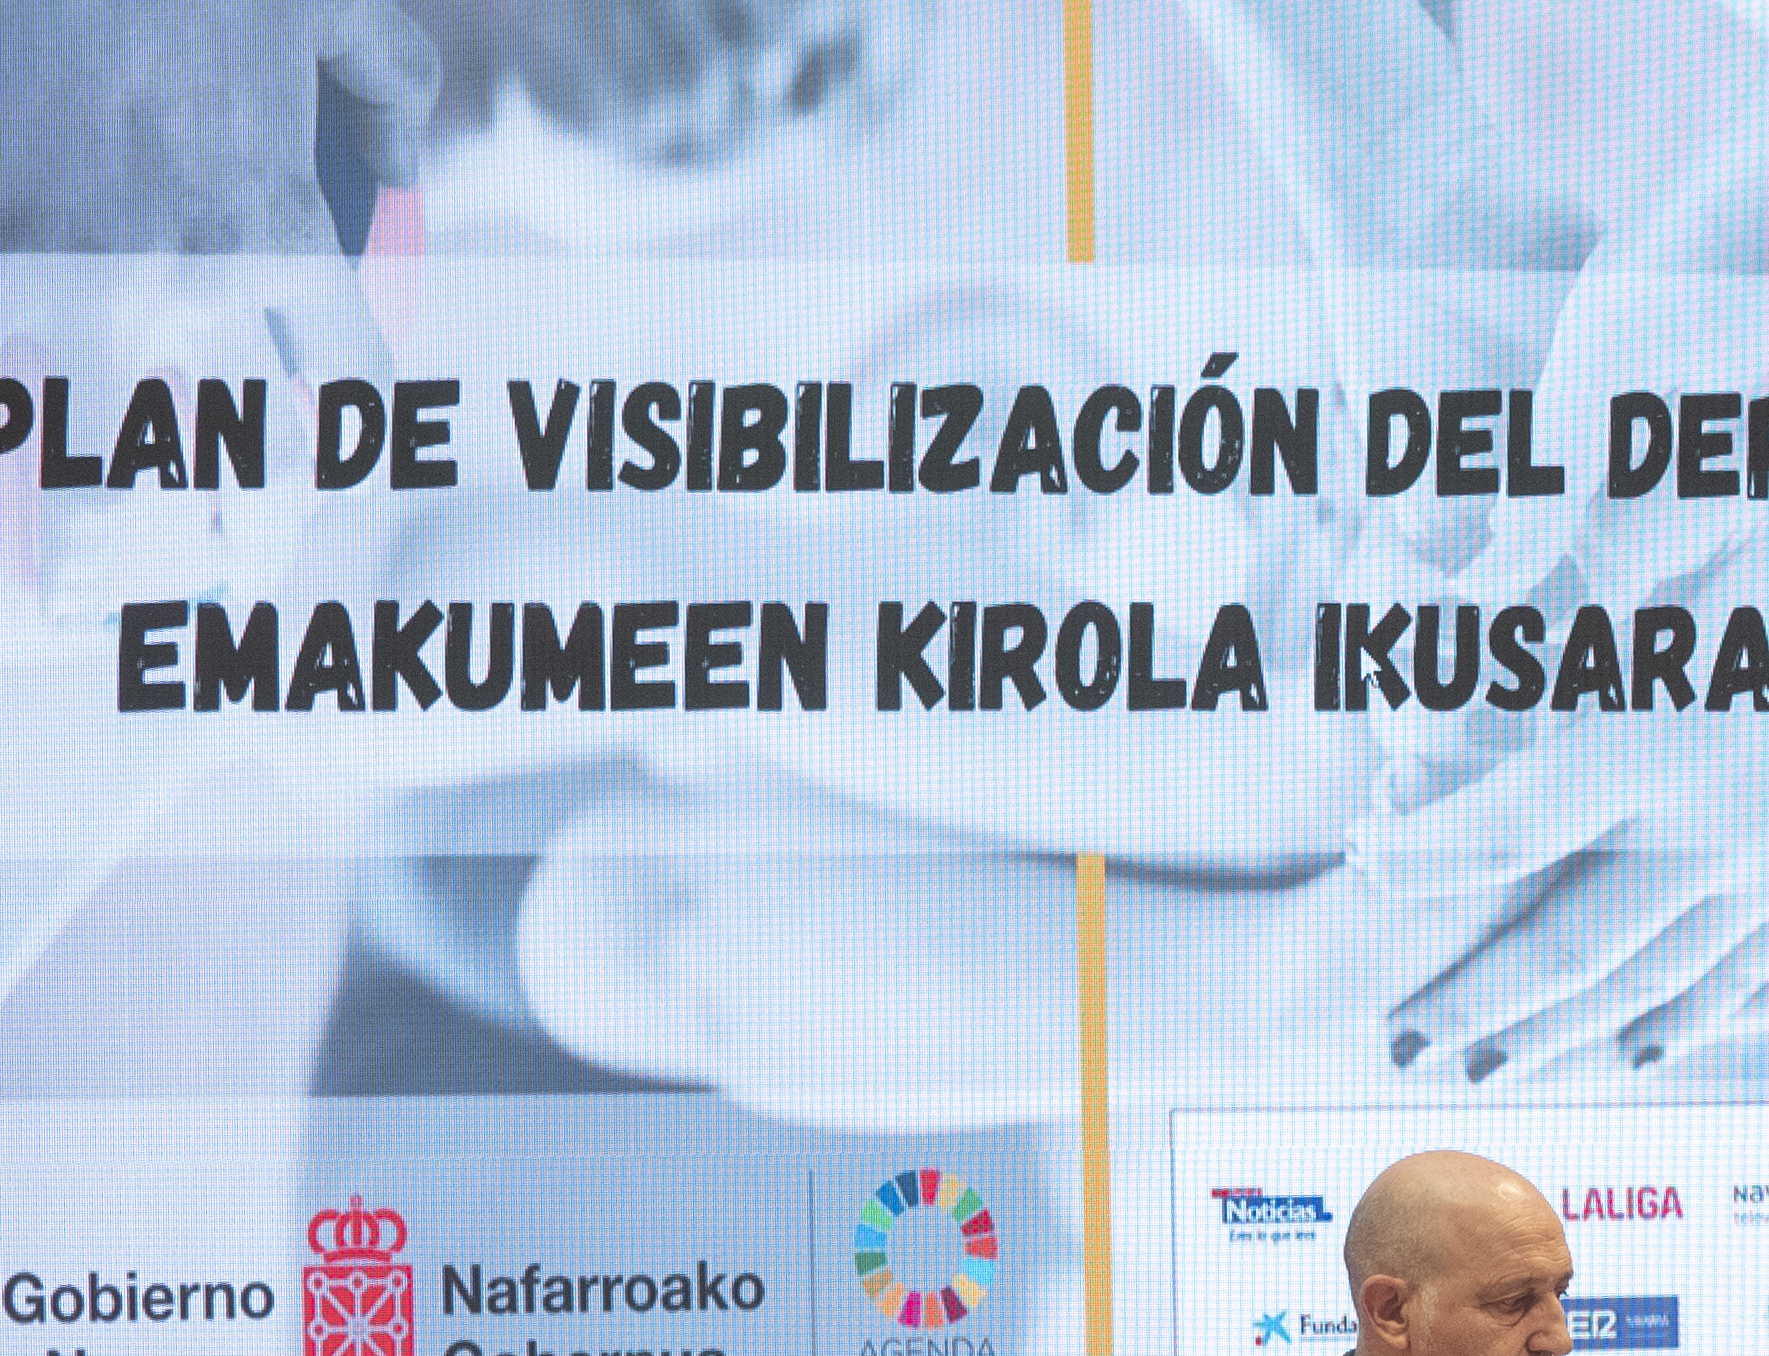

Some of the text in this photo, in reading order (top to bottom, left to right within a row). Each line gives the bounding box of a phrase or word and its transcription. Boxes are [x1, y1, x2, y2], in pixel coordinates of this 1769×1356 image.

[315, 378, 461, 490] DE
[506, 351, 1320, 496] VISIBILIZACIÓN
[1365, 387, 1566, 497] DEL
[117, 598, 830, 713] EMAKUMEEN
[875, 600, 1269, 713] KIROLA
[1561, 1186, 1684, 1222] LALIGA
[3, 1270, 275, 1324] Gobierno
[441, 1258, 767, 1317] Nafarroako
